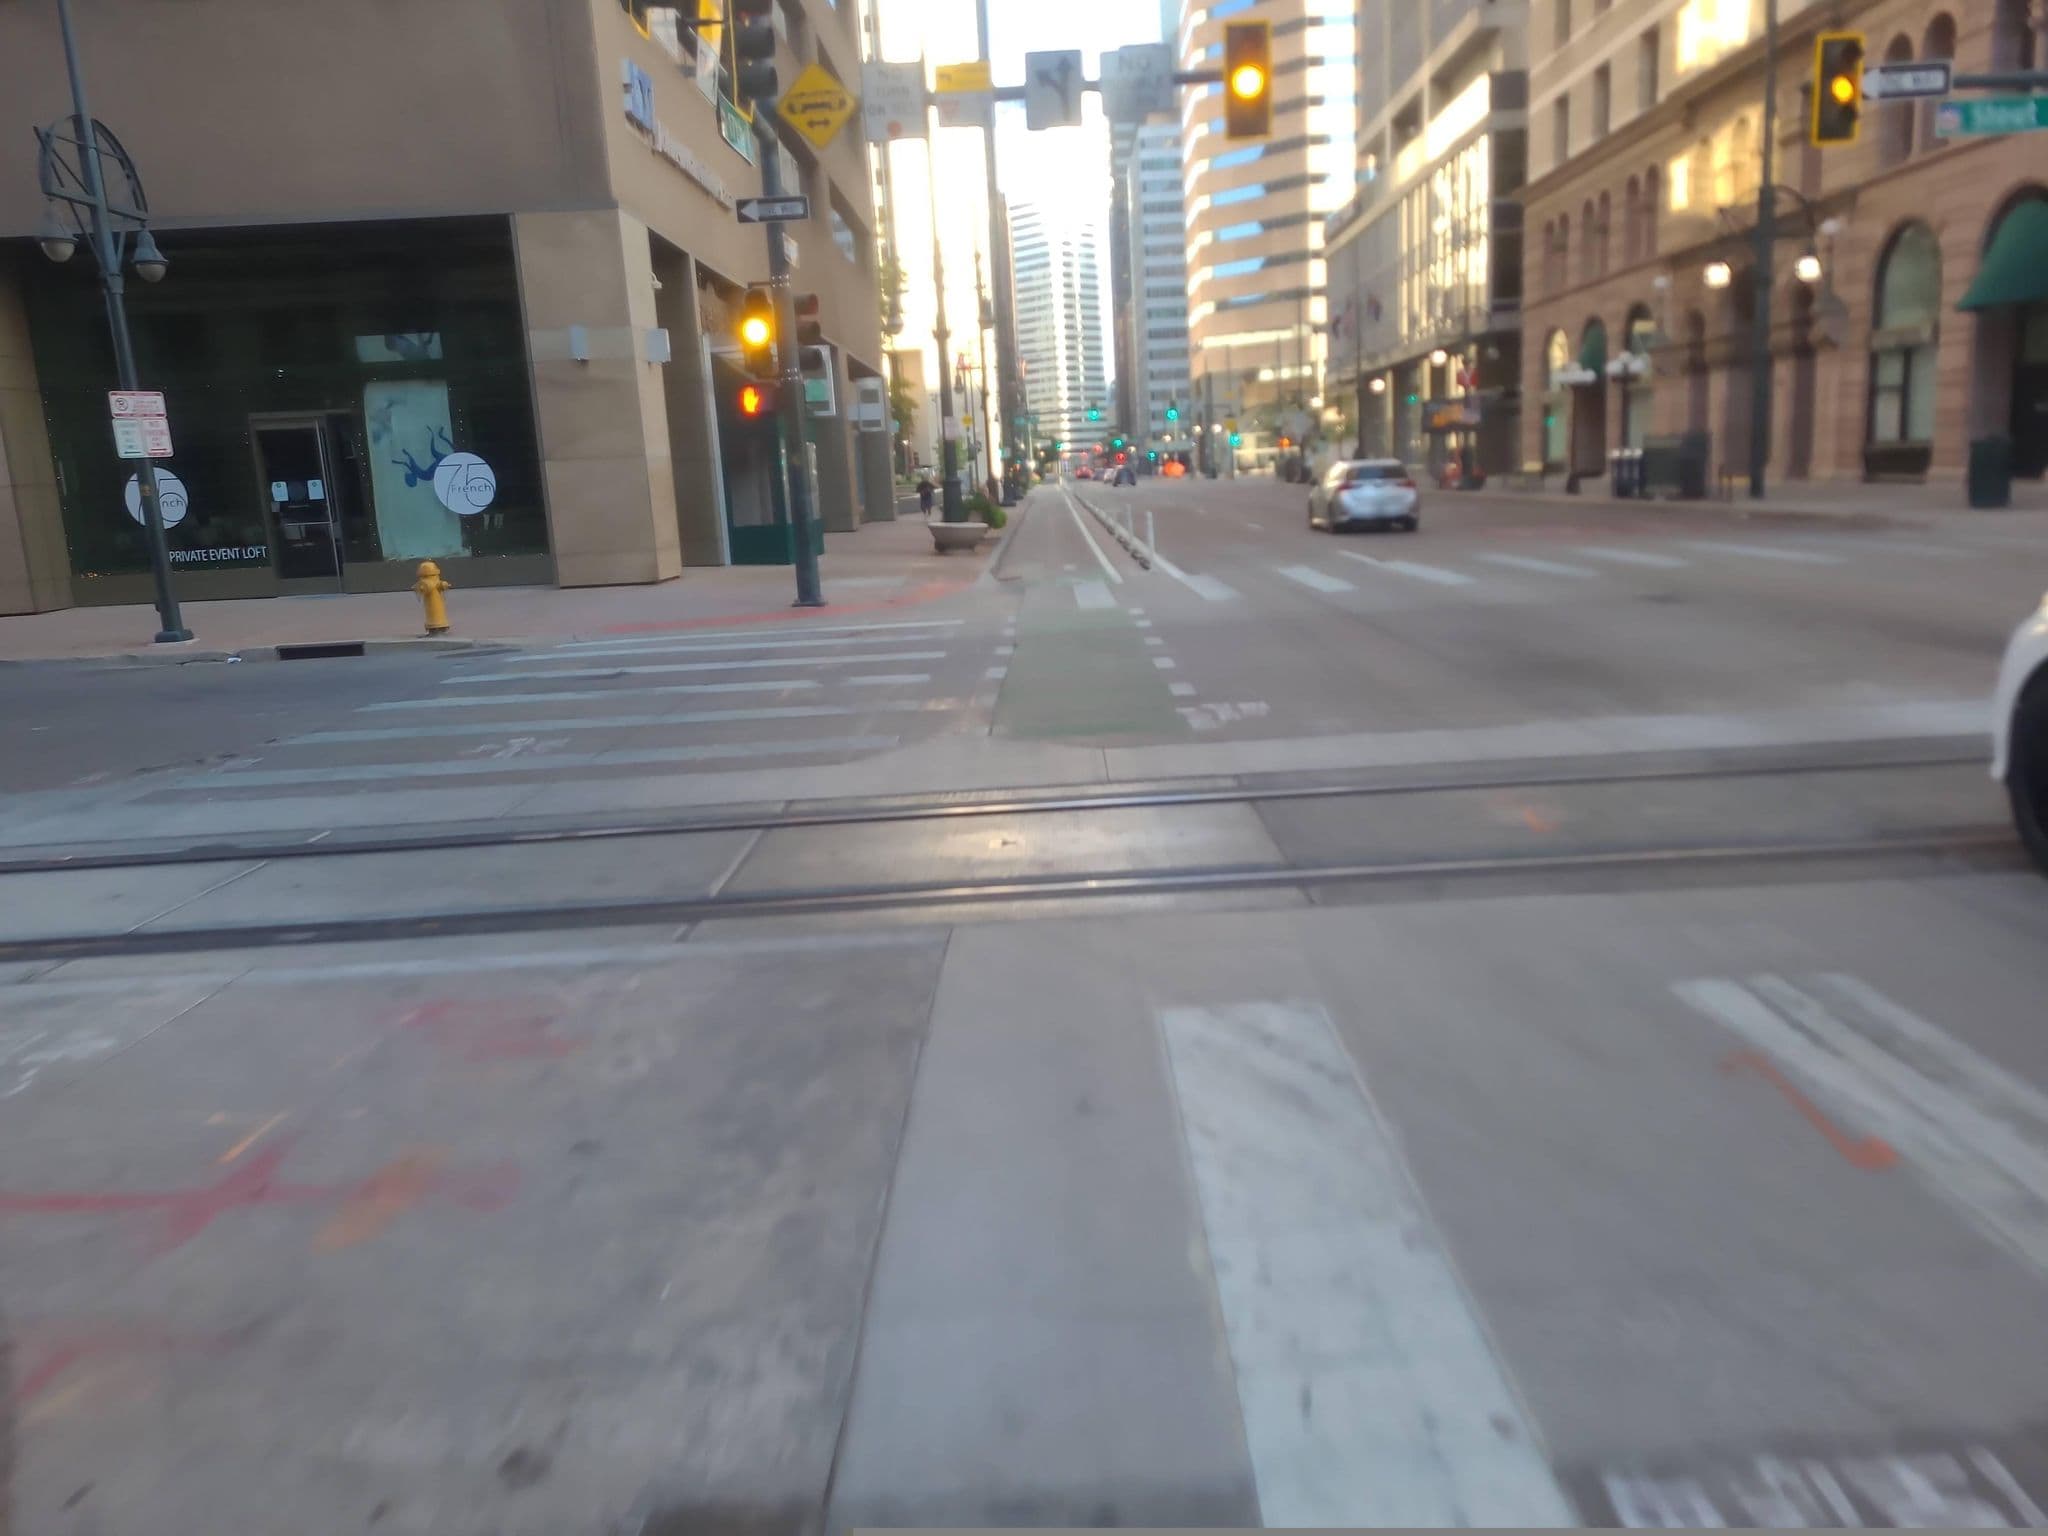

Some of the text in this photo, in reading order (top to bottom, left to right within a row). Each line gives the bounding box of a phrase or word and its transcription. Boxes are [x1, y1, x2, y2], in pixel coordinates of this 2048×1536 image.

[438, 463, 495, 507] 75
[451, 483, 492, 494] French
[169, 546, 267, 562] PRIVATE EVENT LOFT
